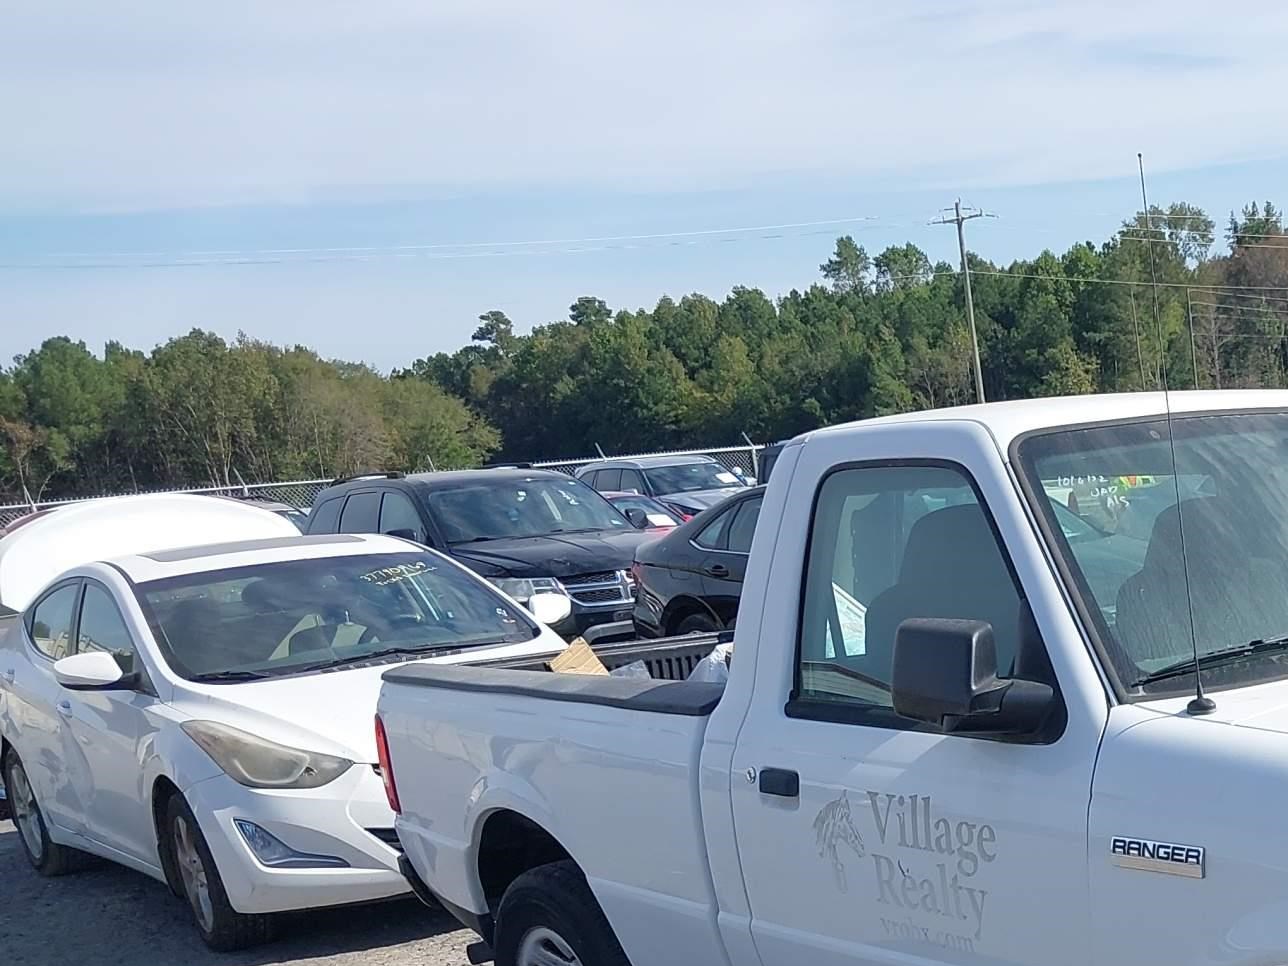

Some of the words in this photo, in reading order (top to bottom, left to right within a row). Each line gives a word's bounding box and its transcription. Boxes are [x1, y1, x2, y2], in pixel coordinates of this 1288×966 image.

[866, 791, 997, 877] Village
[1112, 838, 1201, 865] RANGER
[871, 853, 988, 941] Realty
